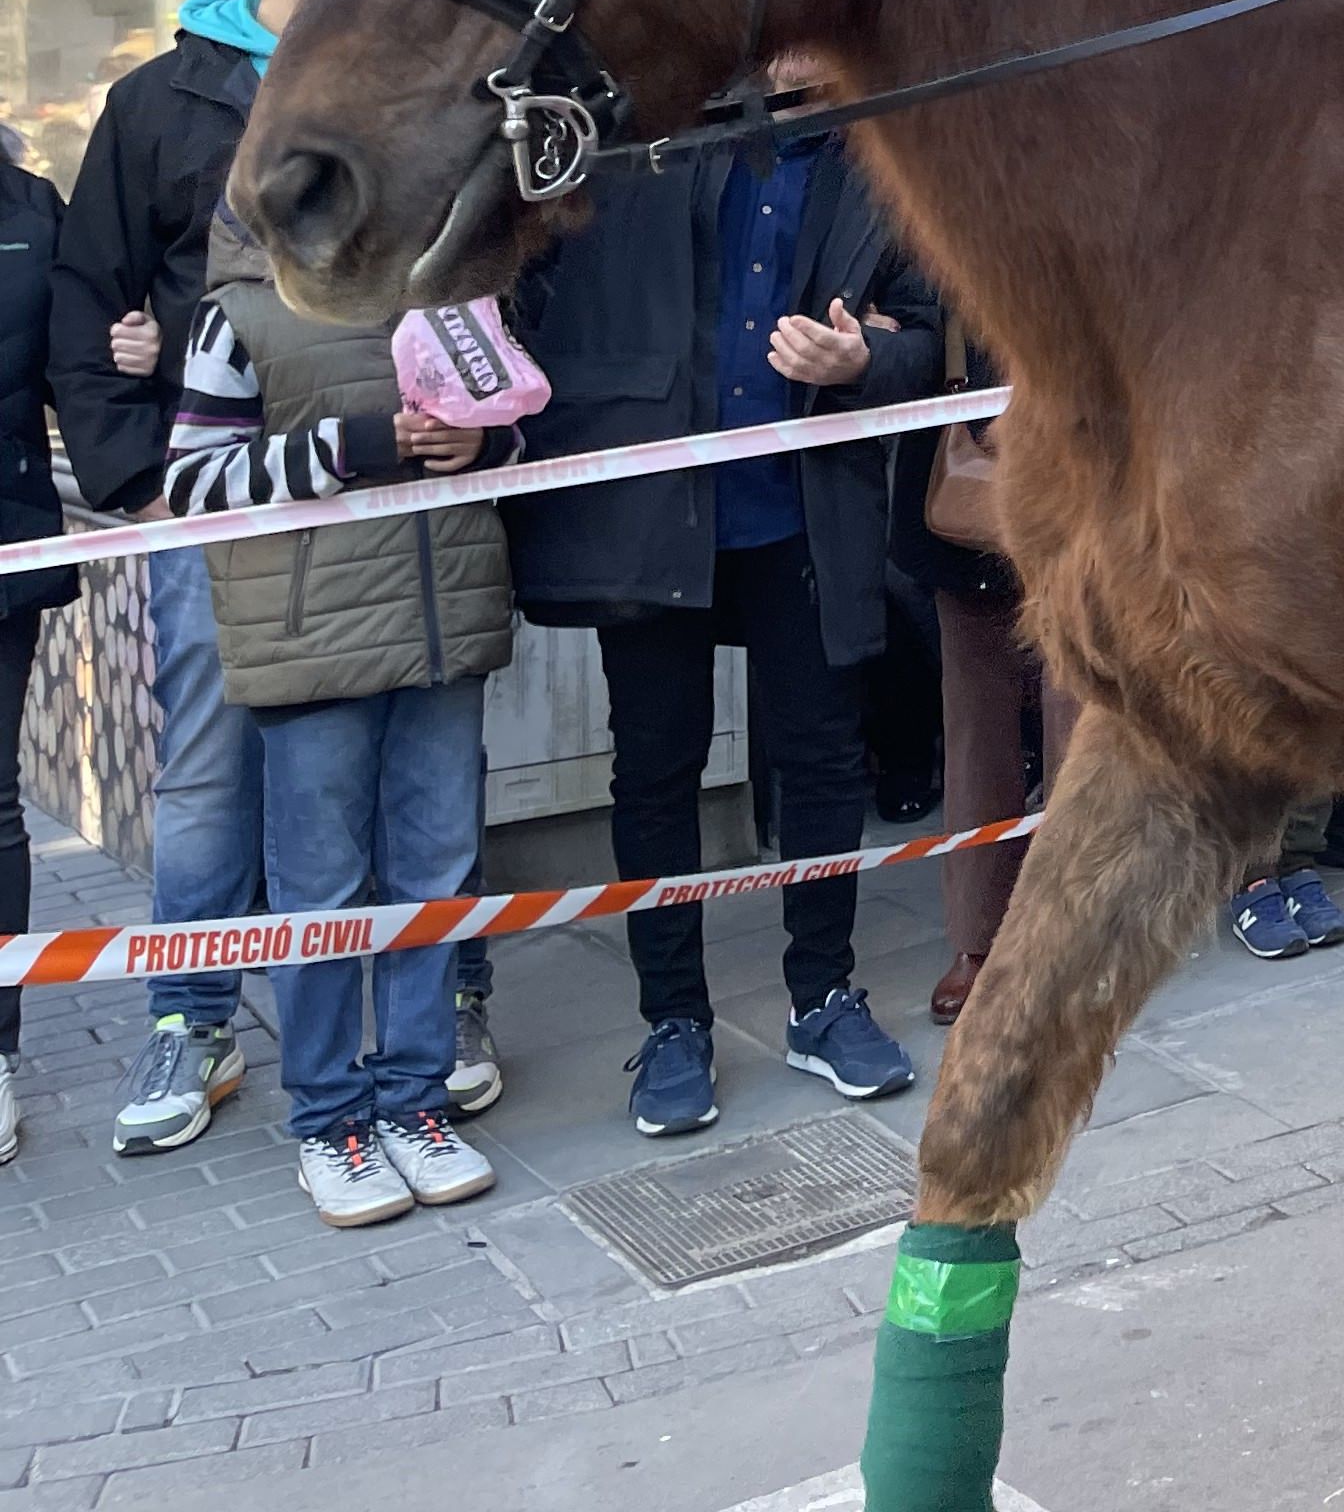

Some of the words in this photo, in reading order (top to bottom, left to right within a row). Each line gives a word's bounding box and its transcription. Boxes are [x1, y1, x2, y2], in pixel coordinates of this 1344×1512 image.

[657, 863, 798, 907] PROTECCIÓ
[126, 917, 293, 974] PROTECCIÓ
[301, 918, 374, 958] CIVIL
